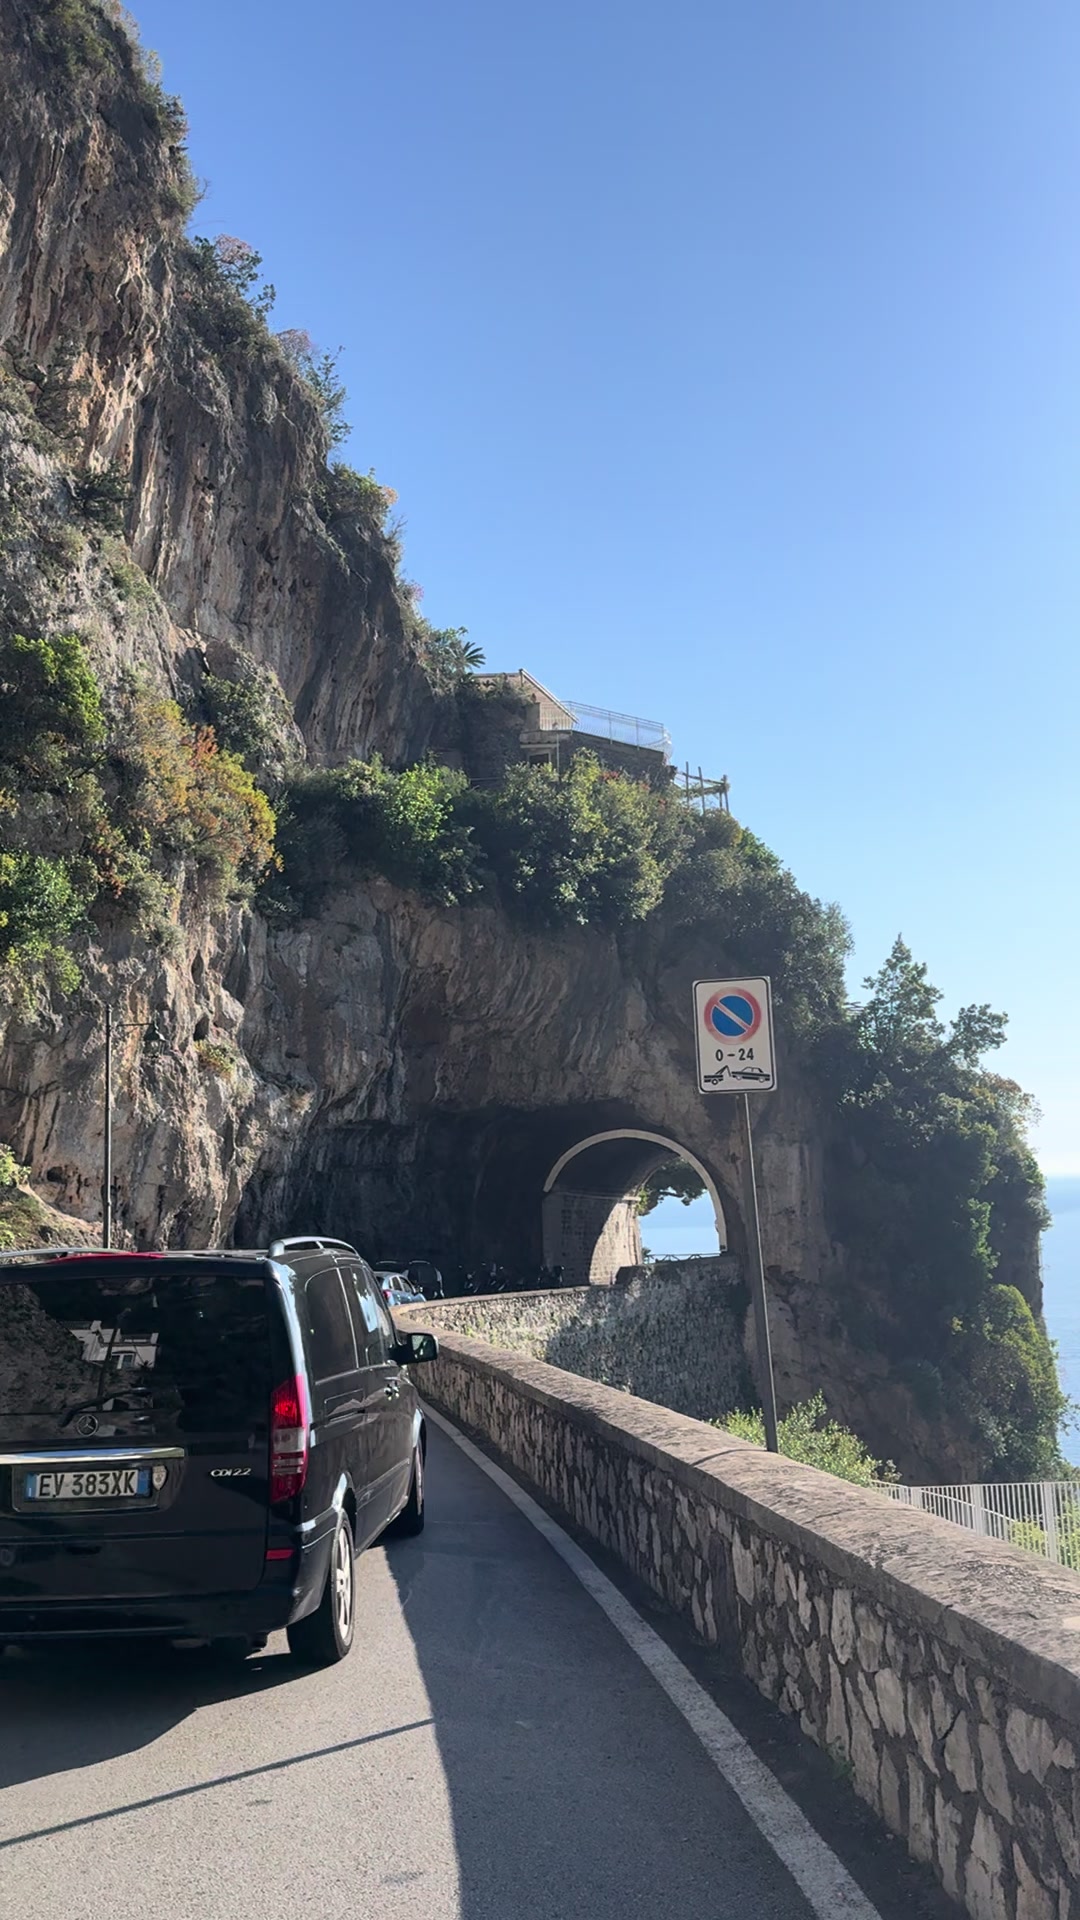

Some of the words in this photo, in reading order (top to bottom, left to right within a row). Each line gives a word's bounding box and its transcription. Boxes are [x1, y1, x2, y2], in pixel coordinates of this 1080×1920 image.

[210, 1468, 233, 1477] CDI
[39, 1474, 65, 1497] EV
[72, 1470, 135, 1496] 383XK
